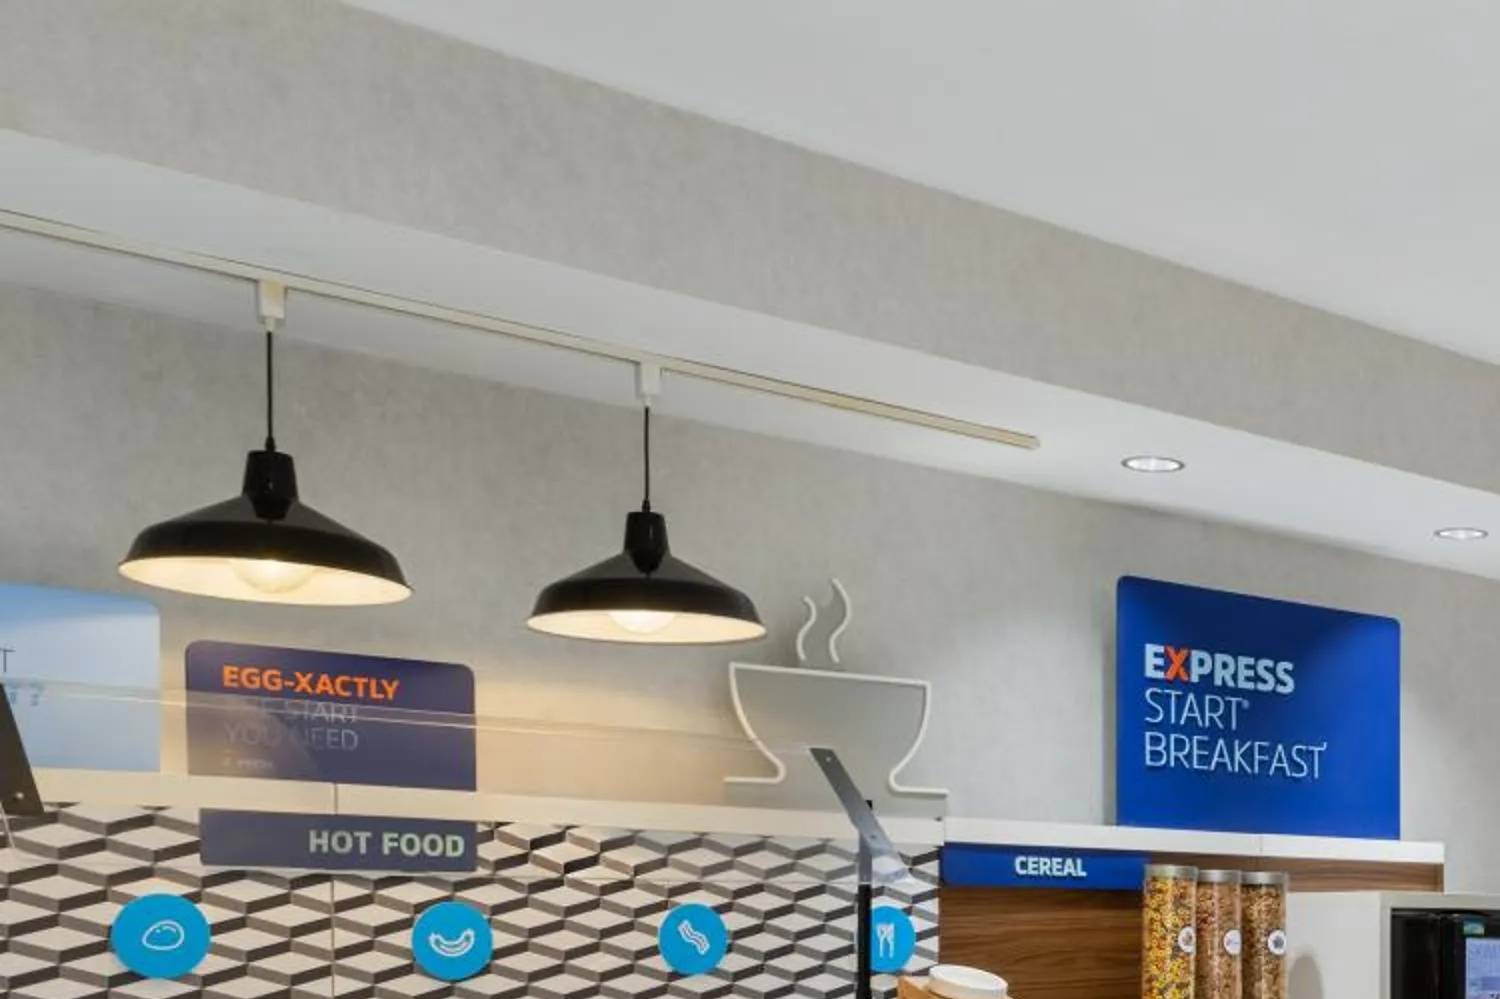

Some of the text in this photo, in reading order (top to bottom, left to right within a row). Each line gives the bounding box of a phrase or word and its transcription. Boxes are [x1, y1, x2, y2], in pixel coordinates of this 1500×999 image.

[222, 664, 399, 700] EGG-XACTLY
[1144, 643, 1295, 694] EXPRESS
[1144, 731, 1327, 779] BREAKFAST
[309, 828, 465, 858] HOT FOOD
[1014, 855, 1087, 878] CEREAL
